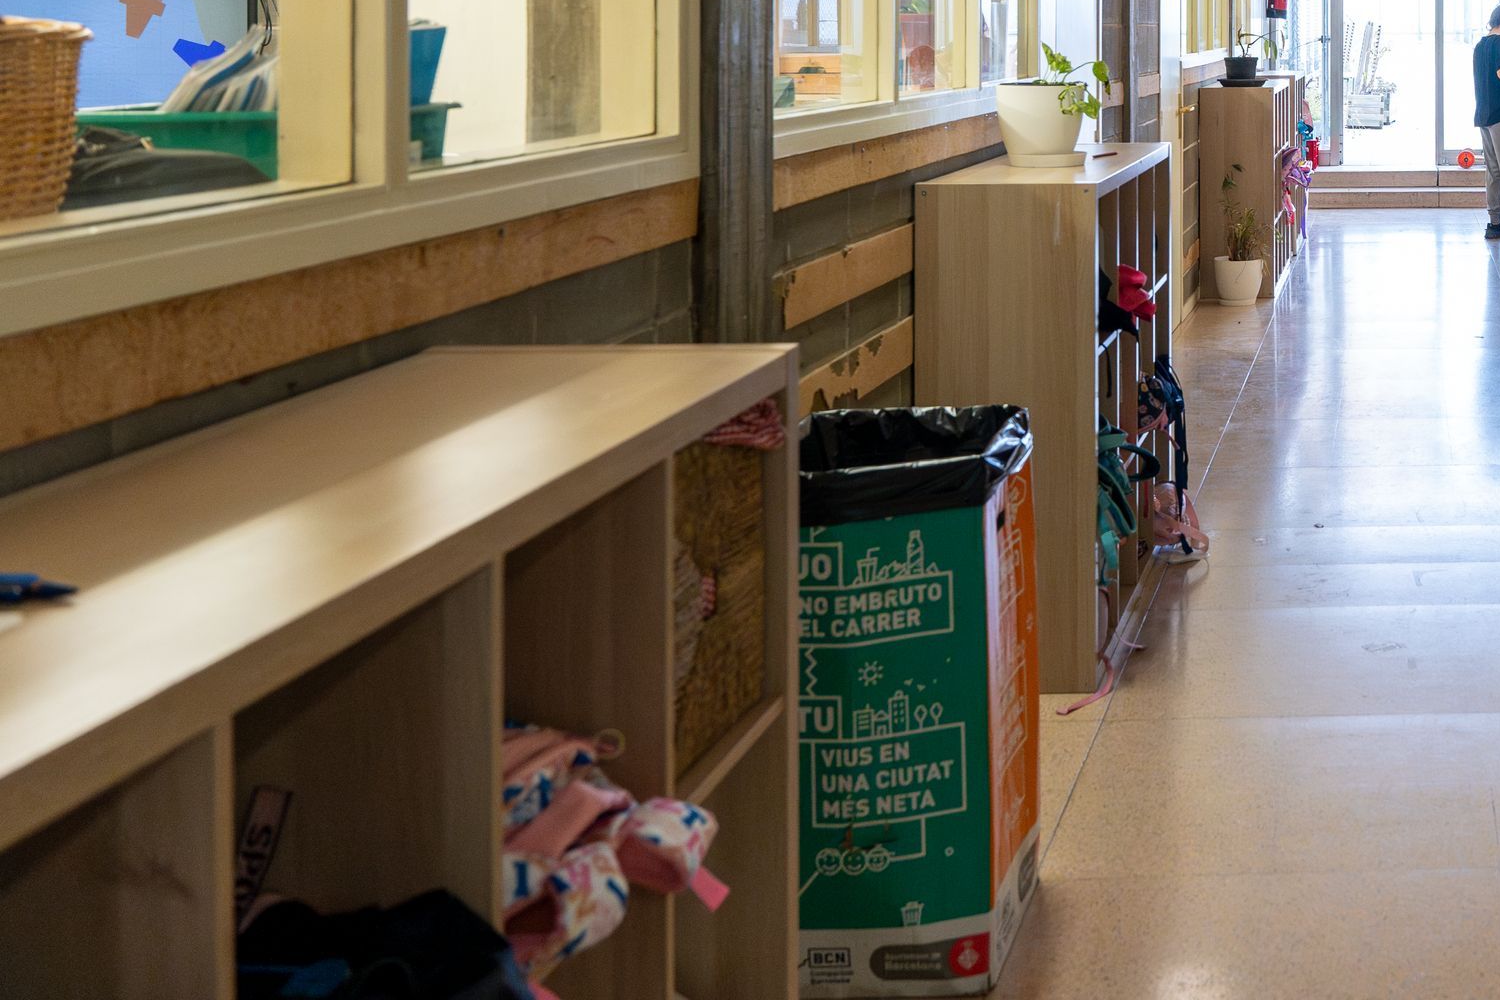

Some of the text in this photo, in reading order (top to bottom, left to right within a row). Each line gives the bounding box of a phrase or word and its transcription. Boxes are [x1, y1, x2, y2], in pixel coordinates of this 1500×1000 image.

[799, 554, 832, 581] JO
[799, 582, 943, 616] NO EMBRUTO
[800, 607, 921, 637] EL CARRER
[798, 706, 835, 733] TU
[821, 741, 911, 768] VIUS EN
[822, 759, 955, 793] UNA CIUTAT
[822, 788, 936, 819] MÉS NETA
[813, 952, 845, 964] BCN
